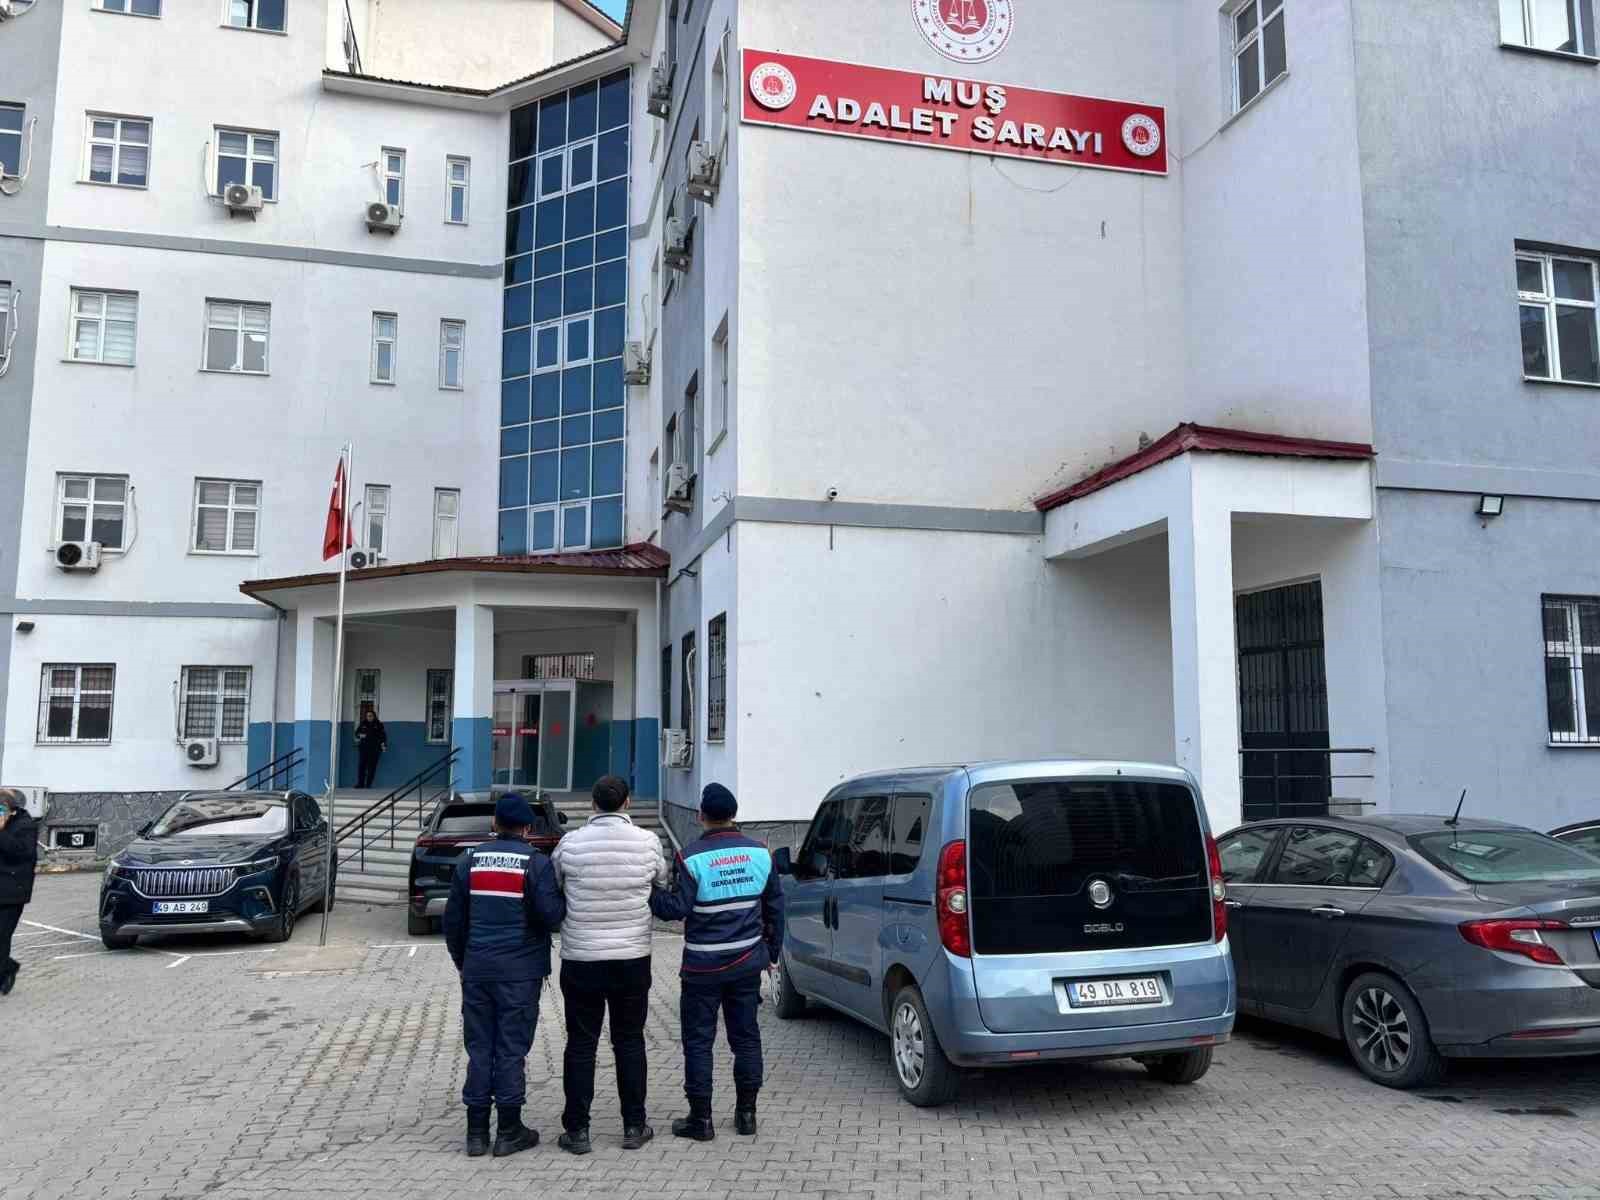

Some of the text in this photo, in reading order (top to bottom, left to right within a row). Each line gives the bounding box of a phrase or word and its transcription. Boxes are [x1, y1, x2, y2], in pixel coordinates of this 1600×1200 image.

[923, 77, 1008, 115] MUŞ
[808, 94, 1103, 155] ADALET SARAYI
[710, 855, 752, 867] JANDARMA
[160, 902, 207, 912] 49 AB 249
[1079, 980, 1156, 1000] 49 DA 819
